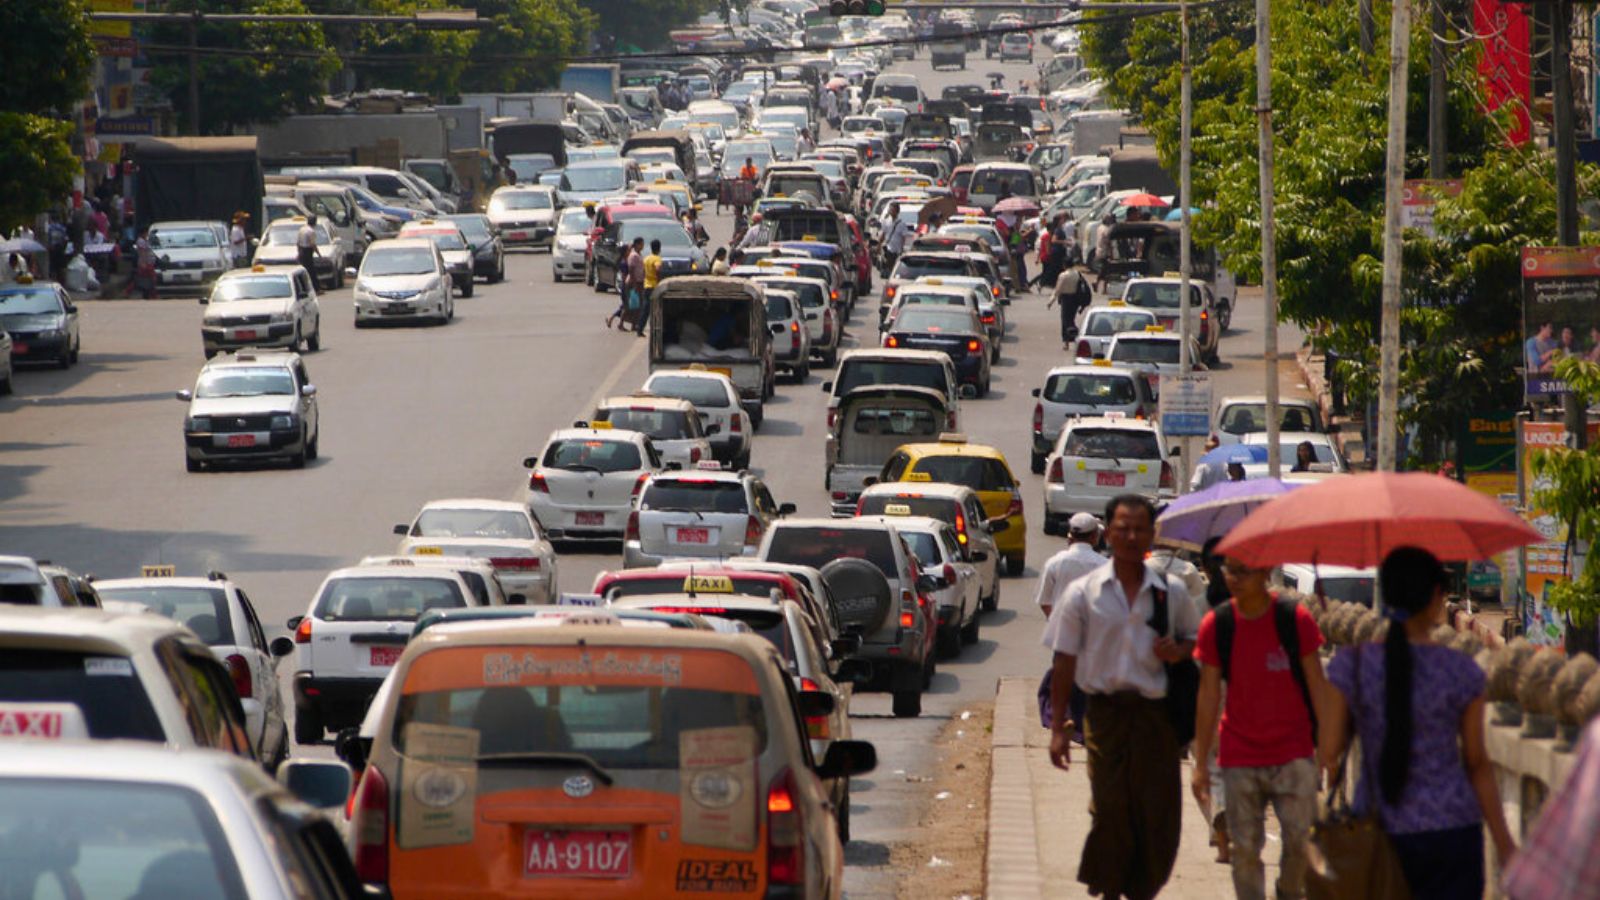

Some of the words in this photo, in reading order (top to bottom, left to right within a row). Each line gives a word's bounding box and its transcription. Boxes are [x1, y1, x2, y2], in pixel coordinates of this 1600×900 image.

[145, 568, 172, 577] TAXI
[692, 577, 726, 588] TAXI
[0, 712, 61, 738] AXI
[527, 841, 629, 870] AA-9107
[678, 861, 756, 880] IDEAL
